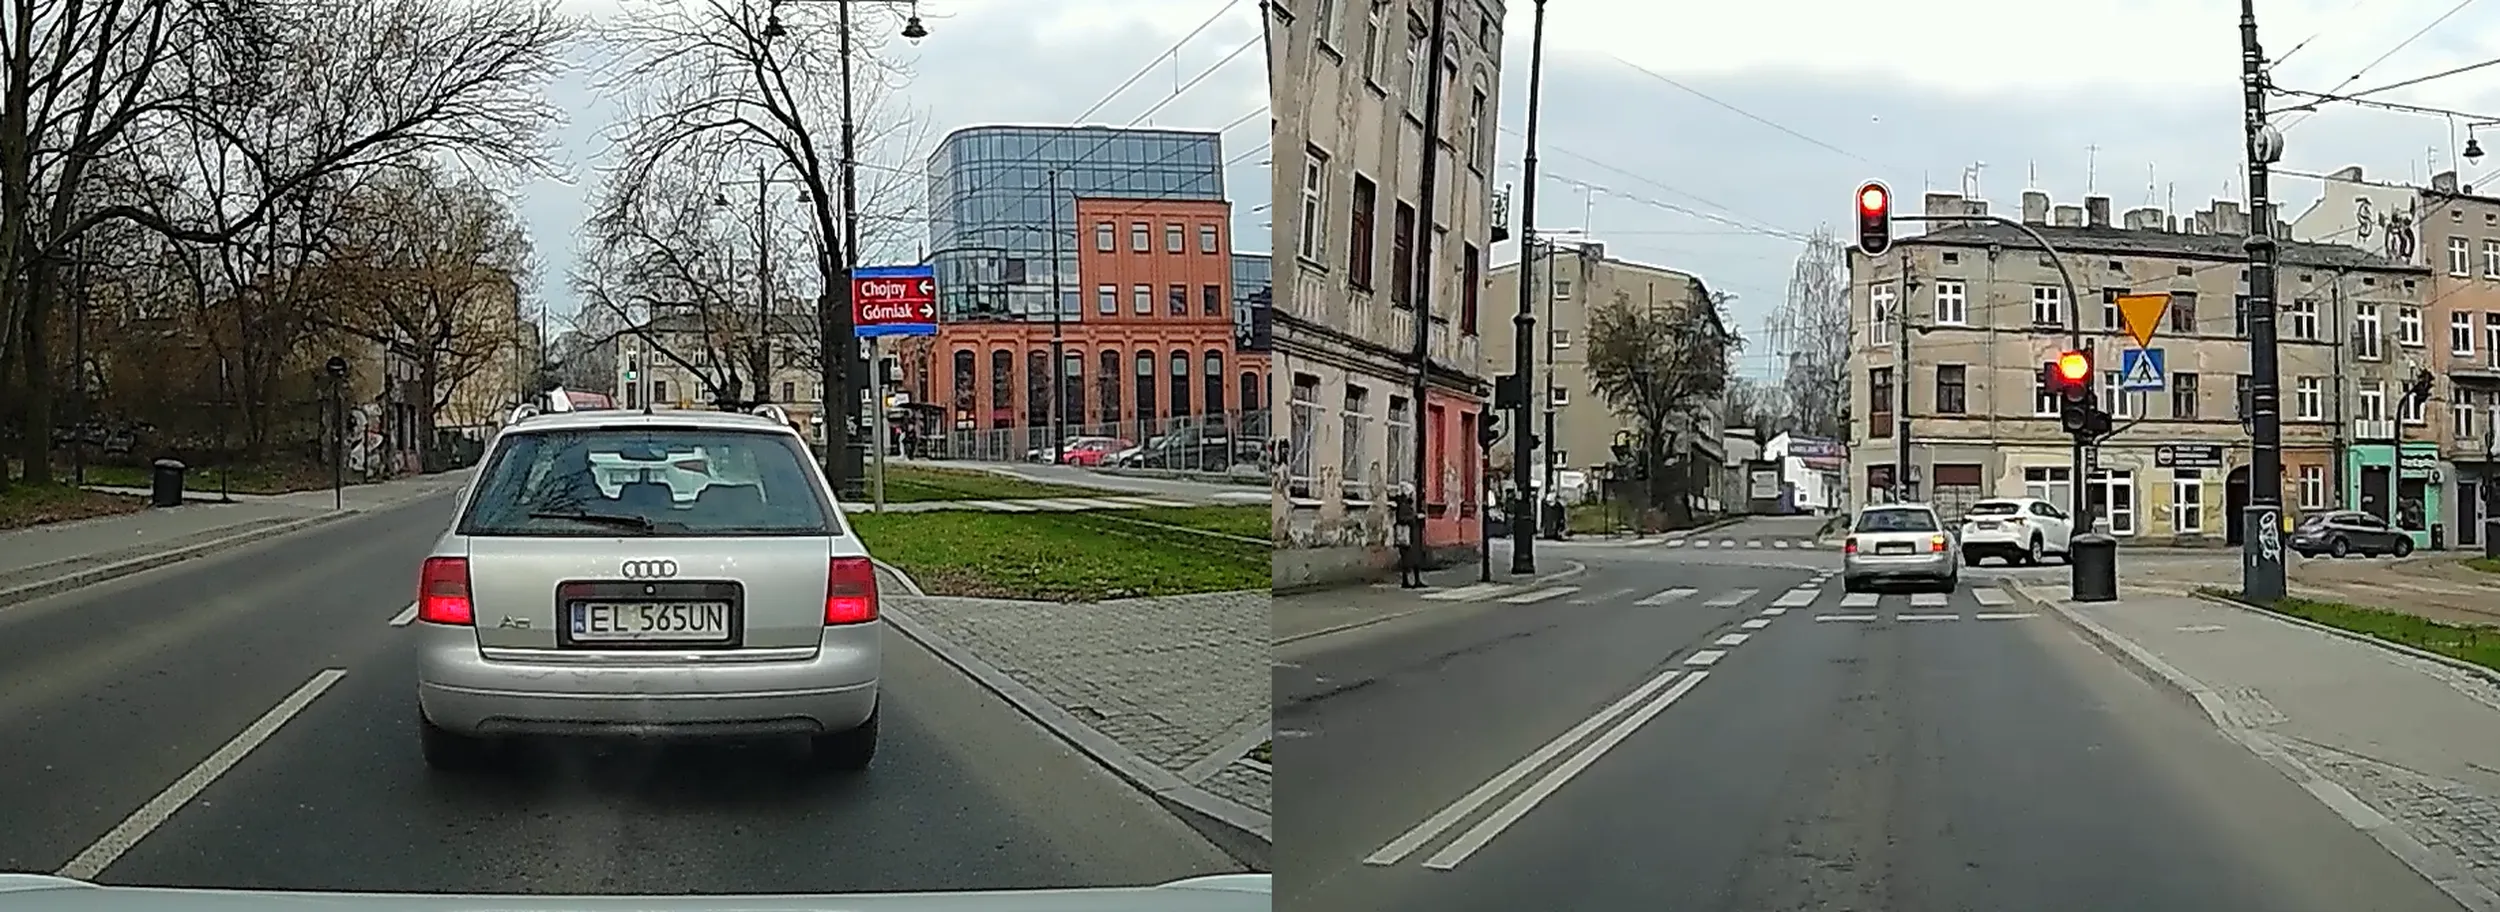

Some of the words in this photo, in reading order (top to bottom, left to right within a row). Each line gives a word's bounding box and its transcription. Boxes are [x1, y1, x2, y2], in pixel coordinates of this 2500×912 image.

[861, 280, 907, 299] Chojny
[862, 303, 913, 320] Górniak
[591, 605, 628, 632] EL
[640, 604, 723, 632] 565UN
